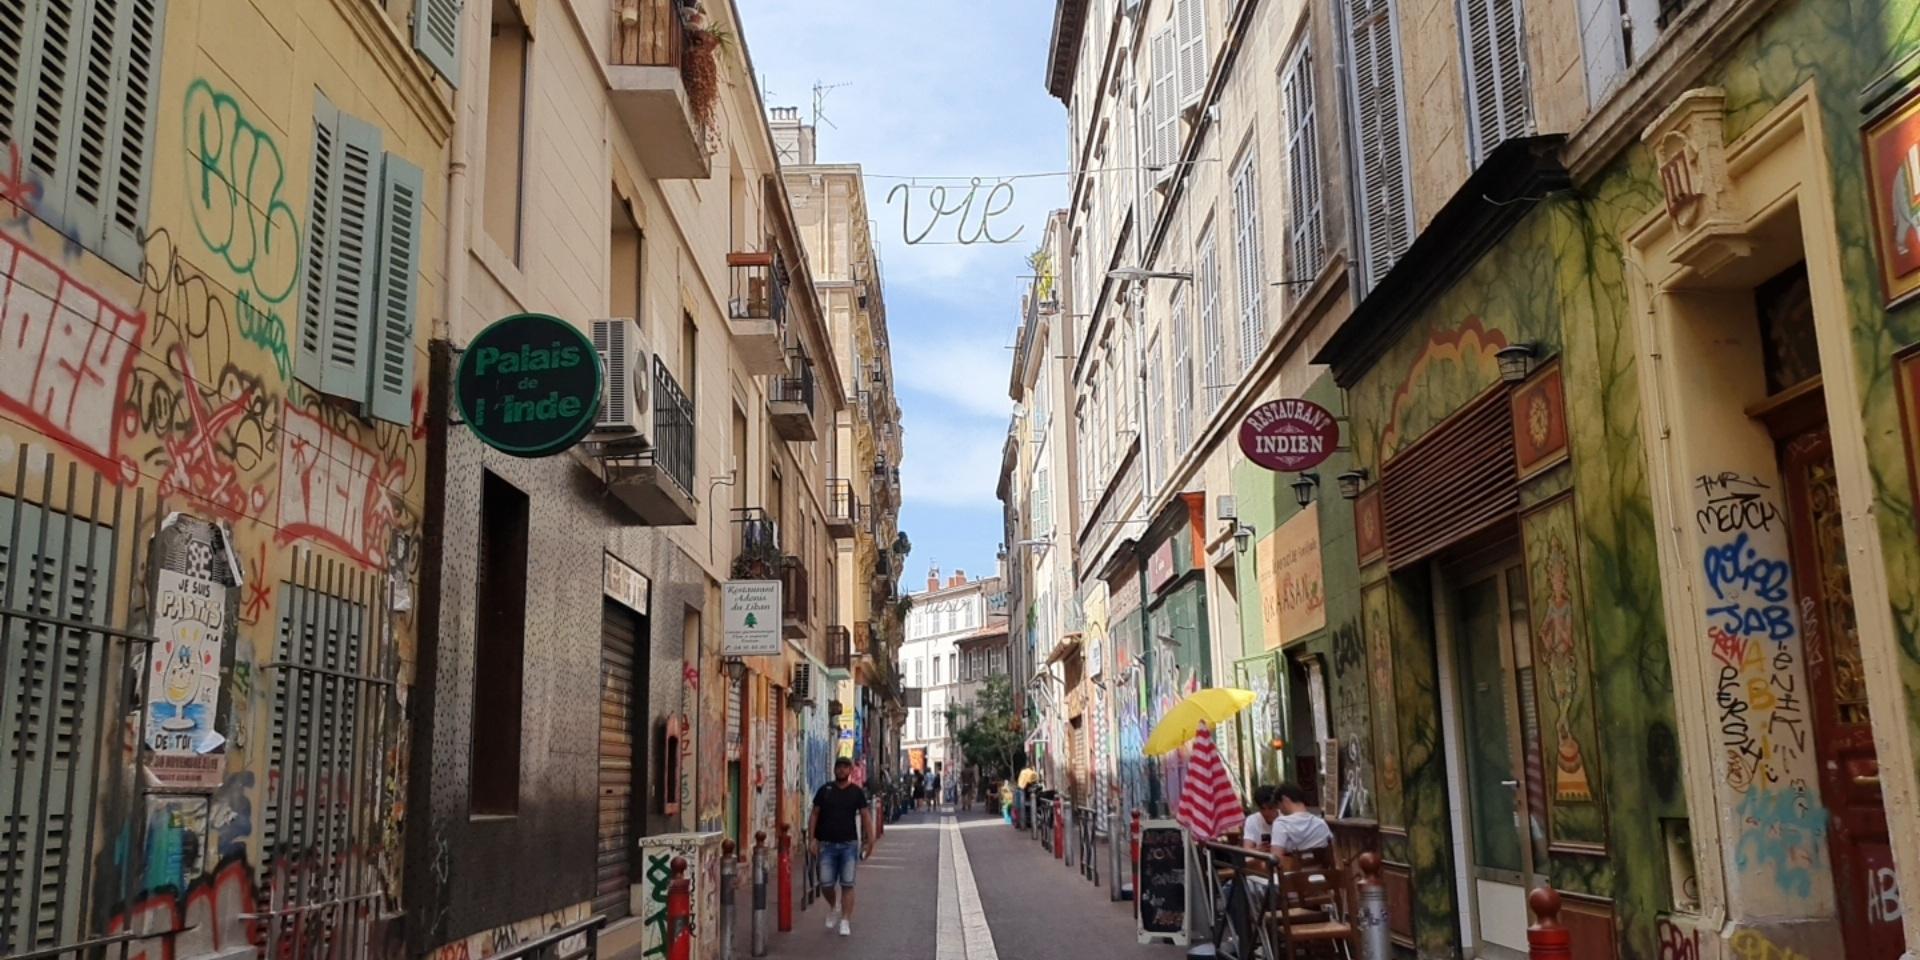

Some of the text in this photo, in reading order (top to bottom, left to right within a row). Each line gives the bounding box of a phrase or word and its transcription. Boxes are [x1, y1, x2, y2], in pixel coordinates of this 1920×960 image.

[887, 177, 1025, 246] vie
[475, 341, 581, 377] Palais
[517, 377, 539, 391] de
[1247, 400, 1332, 432] RESTAURANT
[1255, 435, 1324, 453] INDIEN
[178, 578, 211, 598] JE SUIS
[727, 585, 775, 594] Restaurant
[745, 603, 771, 611] Liban
[155, 734, 192, 750] DE TOI
